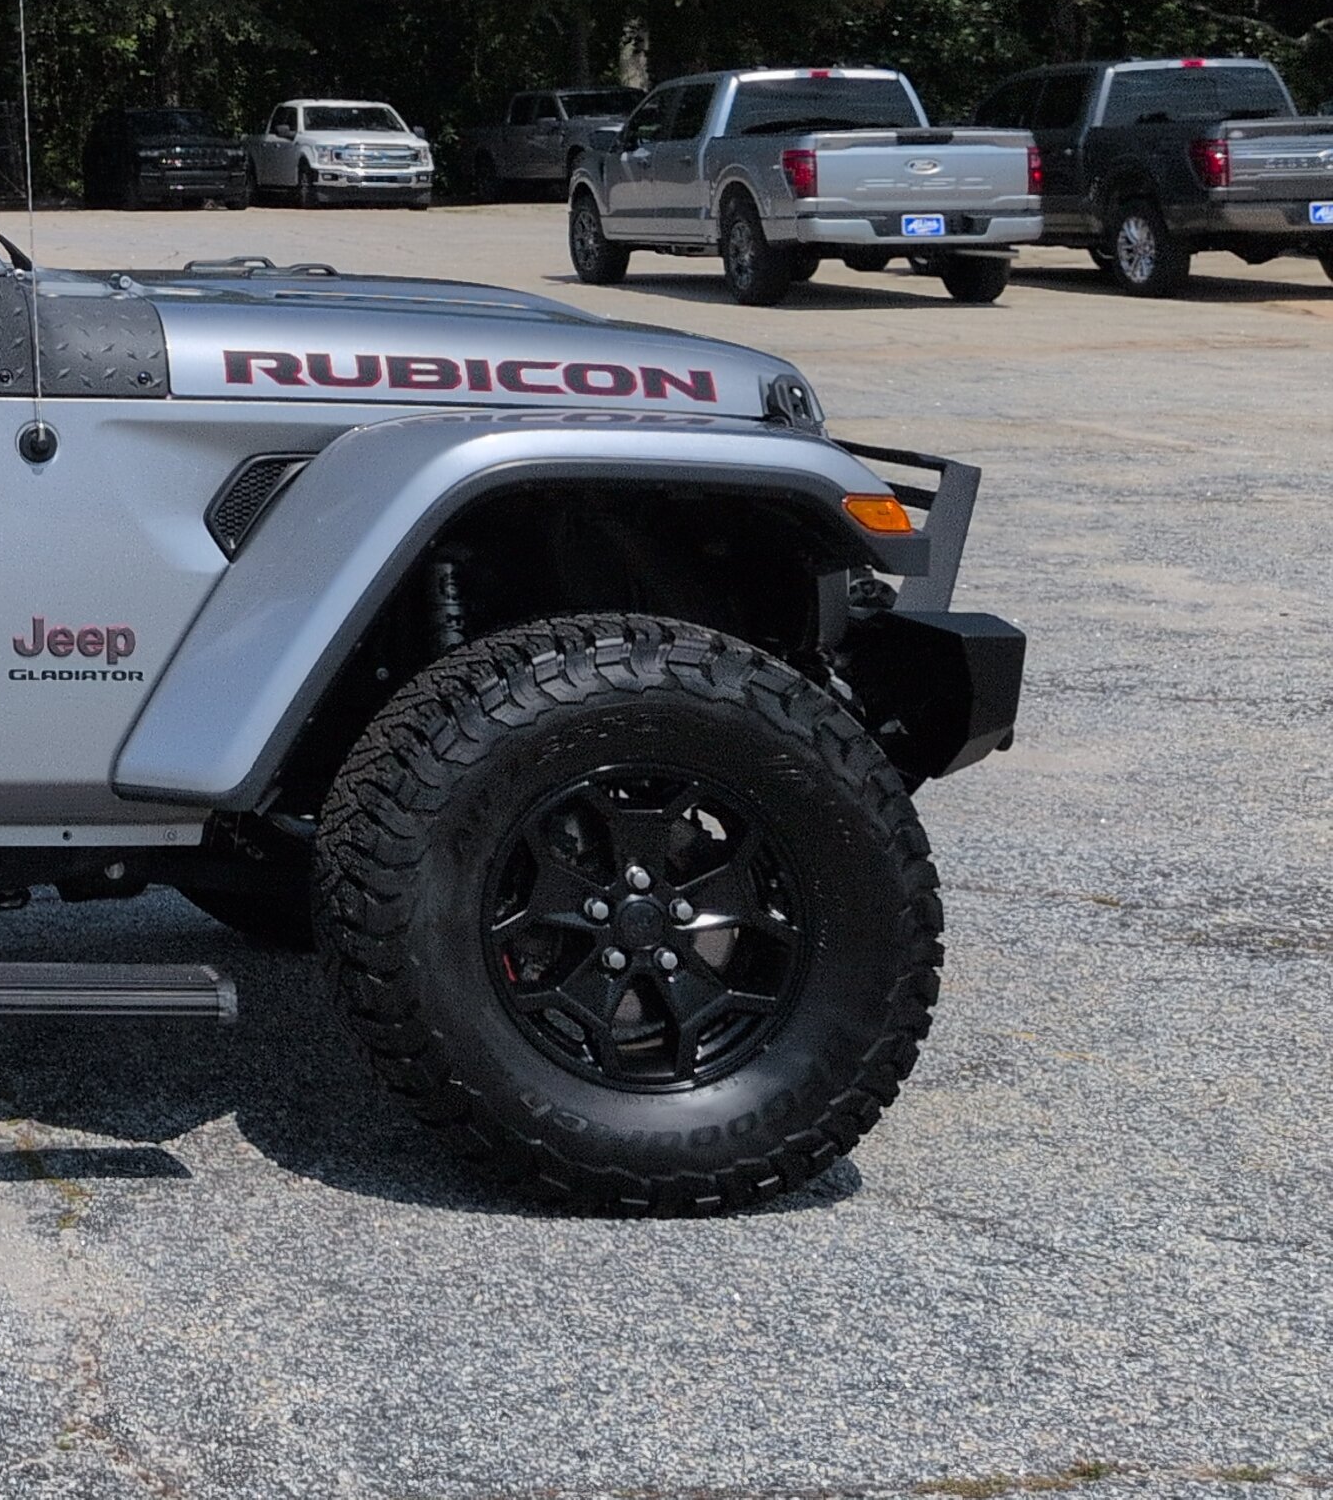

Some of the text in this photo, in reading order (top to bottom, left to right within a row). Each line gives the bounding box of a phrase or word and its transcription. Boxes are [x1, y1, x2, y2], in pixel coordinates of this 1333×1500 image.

[222, 349, 718, 403] RUBICON
[12, 614, 136, 666] Jeep
[8, 668, 145, 682] GLADIATOR
